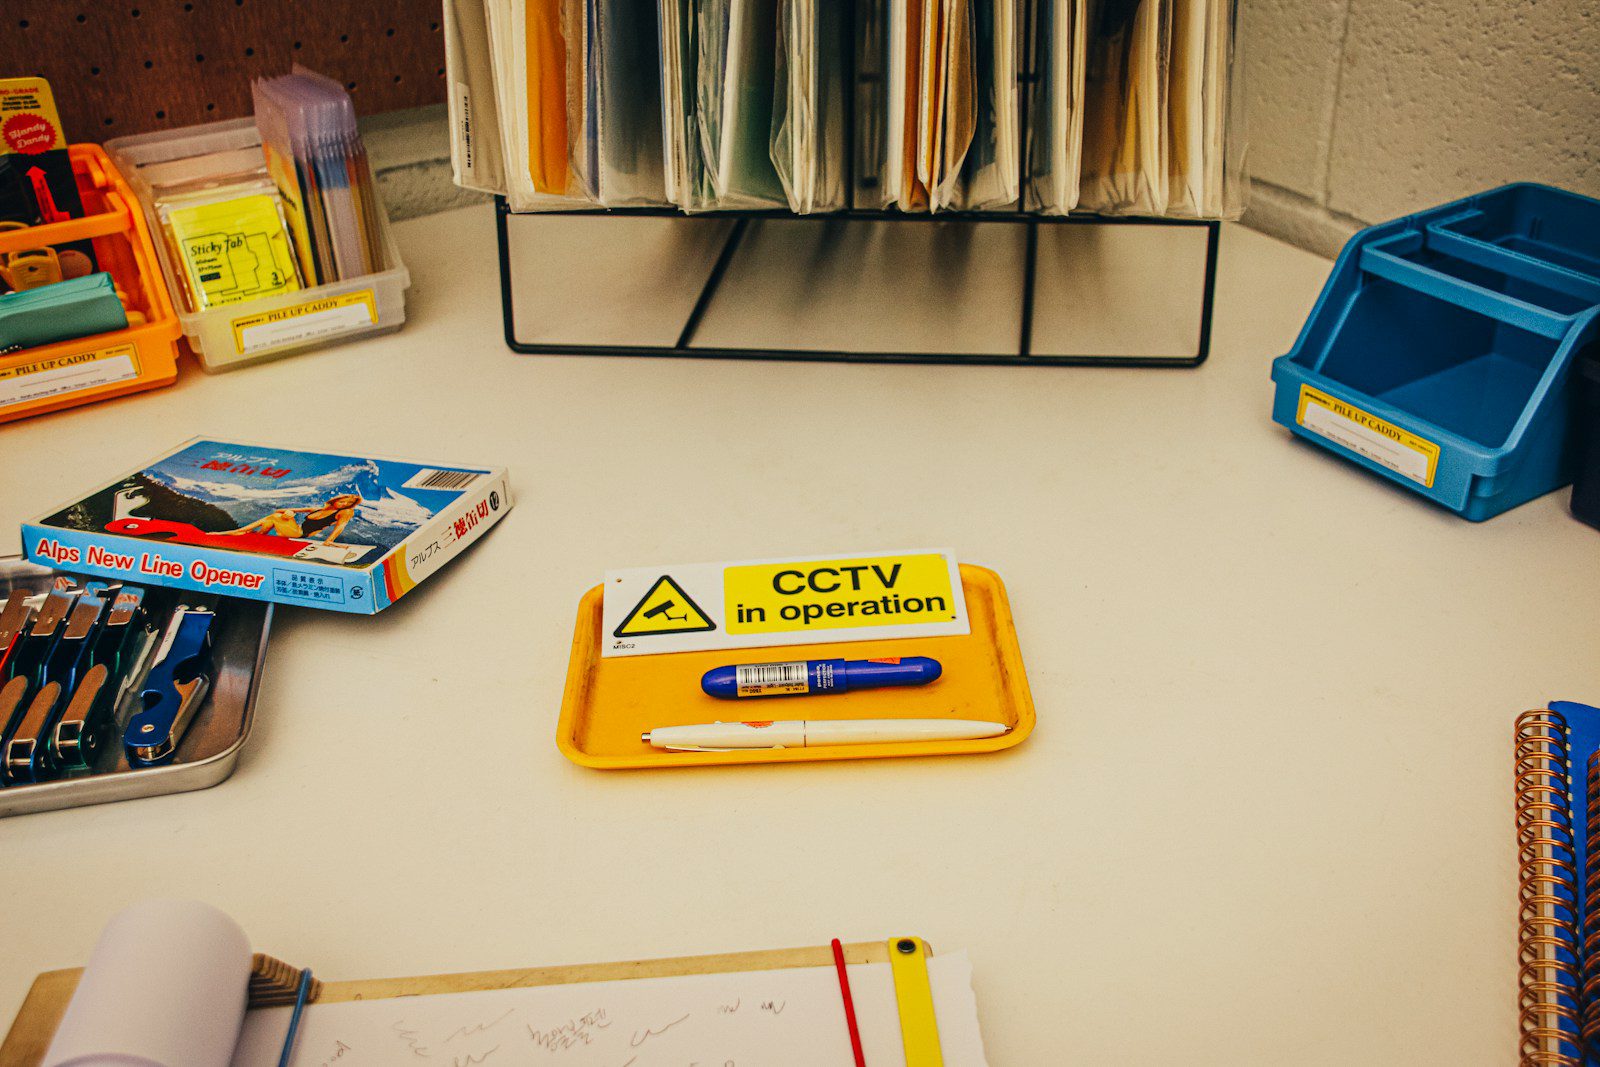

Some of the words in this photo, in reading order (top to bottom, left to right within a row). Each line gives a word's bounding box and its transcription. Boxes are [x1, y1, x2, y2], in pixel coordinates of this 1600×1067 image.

[8, 122, 46, 139] Handy
[16, 133, 50, 148] Dandy
[190, 241, 222, 257] Sticky
[224, 236, 243, 254] Tab
[268, 311, 287, 322] PILE
[290, 308, 303, 317] UP
[305, 300, 339, 314] CADDY
[15, 364, 38, 377] PILE
[42, 361, 56, 370] UP
[58, 352, 97, 368] CADDY
[1333, 404, 1351, 418] PILE
[1354, 413, 1368, 425] UP
[1368, 417, 1401, 441] CADDY
[36, 538, 80, 566] Alps
[88, 546, 134, 570] New
[141, 554, 182, 577] Line
[191, 561, 265, 591] Opener
[411, 541, 442, 569] アルプス
[772, 563, 903, 596] CCTV
[737, 602, 766, 623] in
[780, 594, 946, 625] operation
